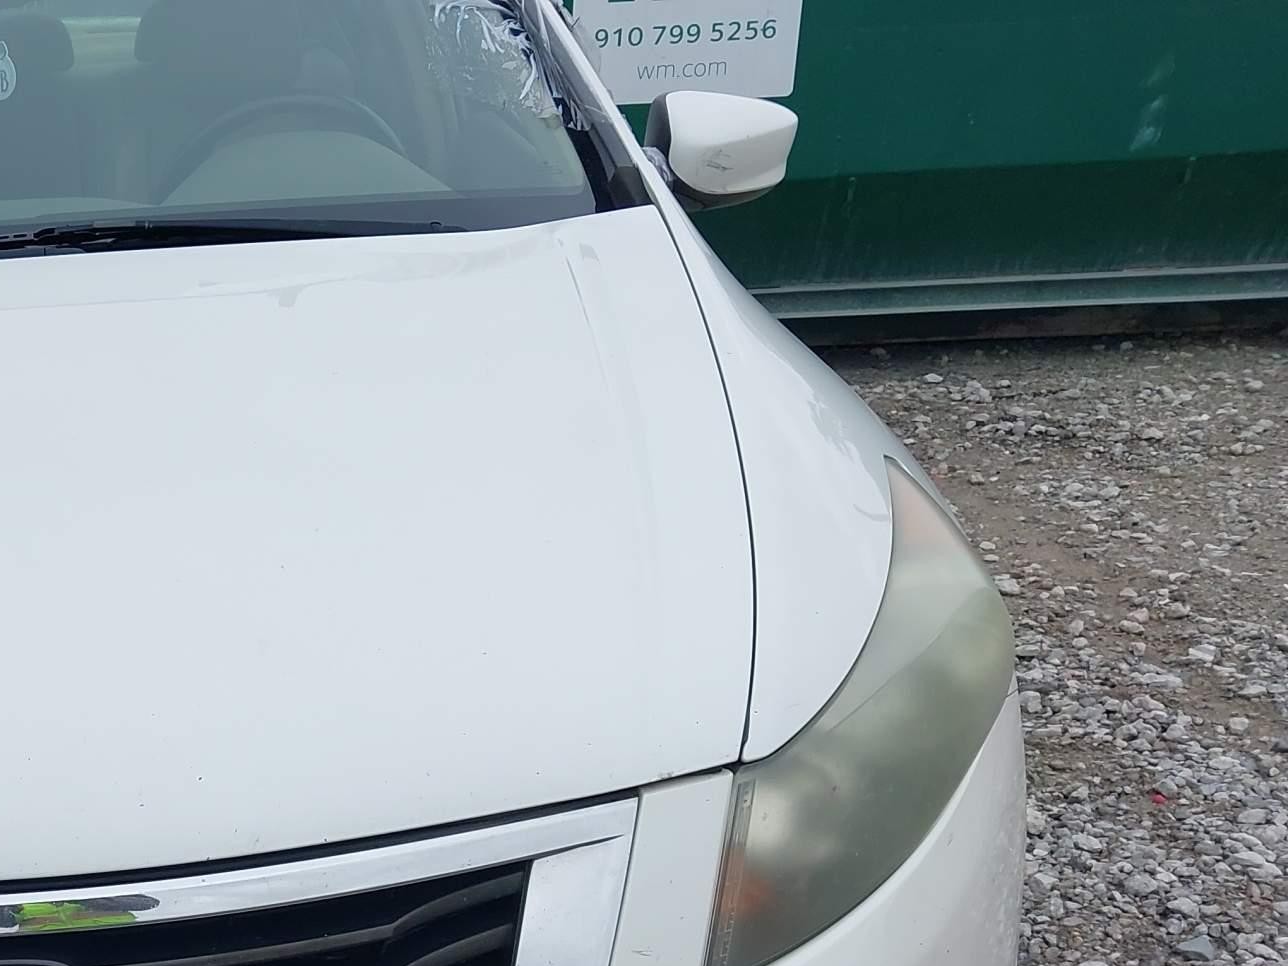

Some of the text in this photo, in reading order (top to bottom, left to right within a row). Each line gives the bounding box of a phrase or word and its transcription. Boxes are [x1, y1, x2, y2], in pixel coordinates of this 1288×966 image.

[594, 19, 778, 49] 910 799 5256
[636, 60, 728, 81] wm.com
